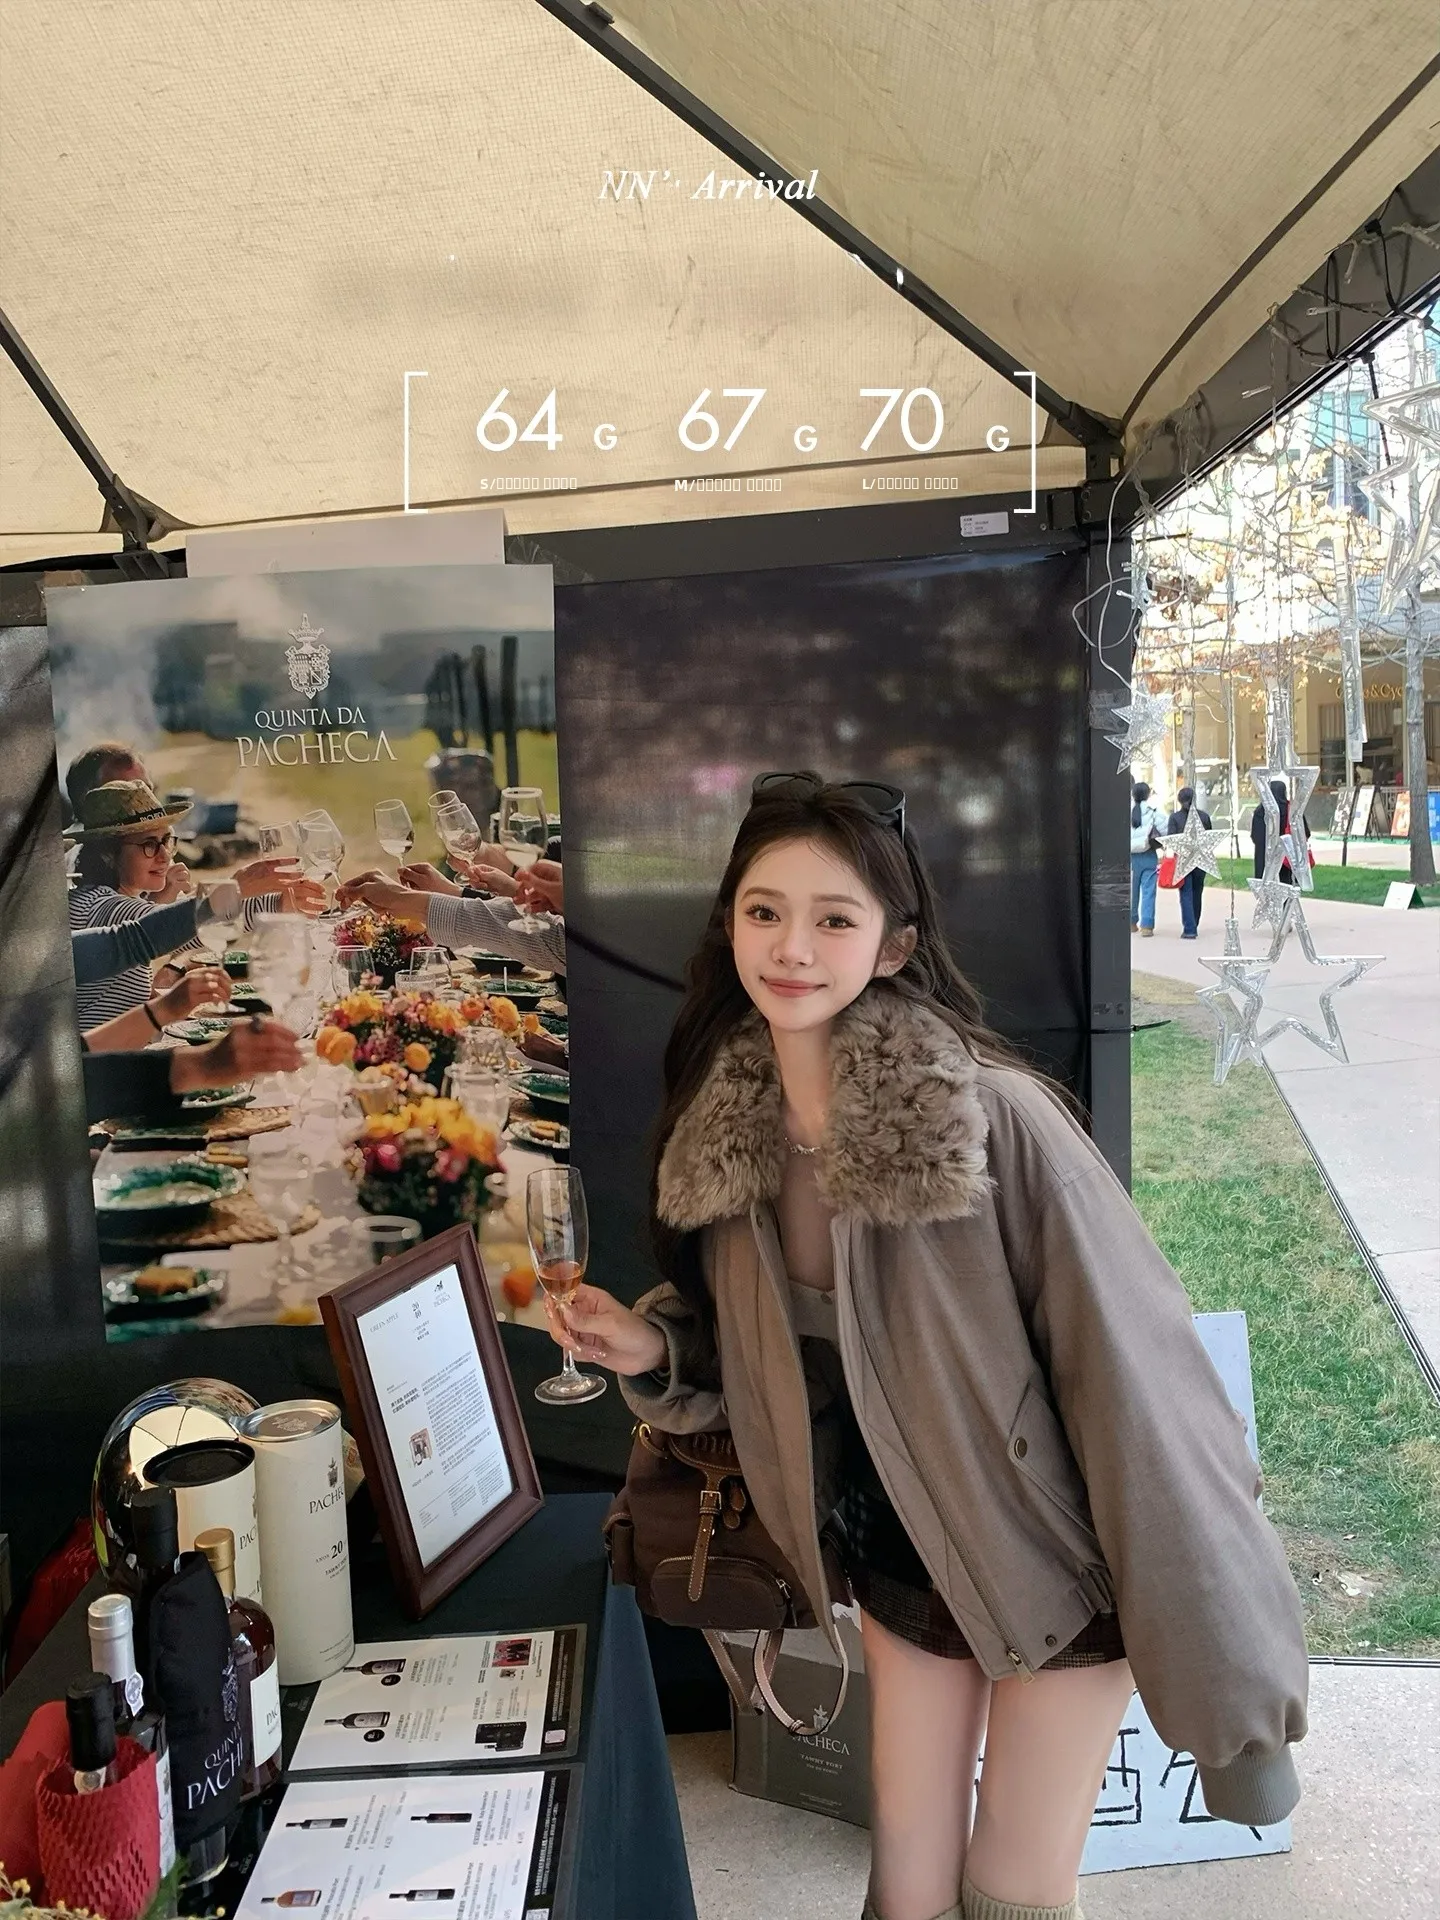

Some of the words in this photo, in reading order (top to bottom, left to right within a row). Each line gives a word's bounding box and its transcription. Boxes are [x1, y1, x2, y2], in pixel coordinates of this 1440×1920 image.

[254, 707, 331, 732] QUINTA
[337, 706, 366, 724] DA
[235, 730, 398, 768] PACHECA
[309, 1484, 344, 1514] PACHE
[331, 1540, 343, 1559] 20
[793, 1735, 850, 1756] ACHECA
